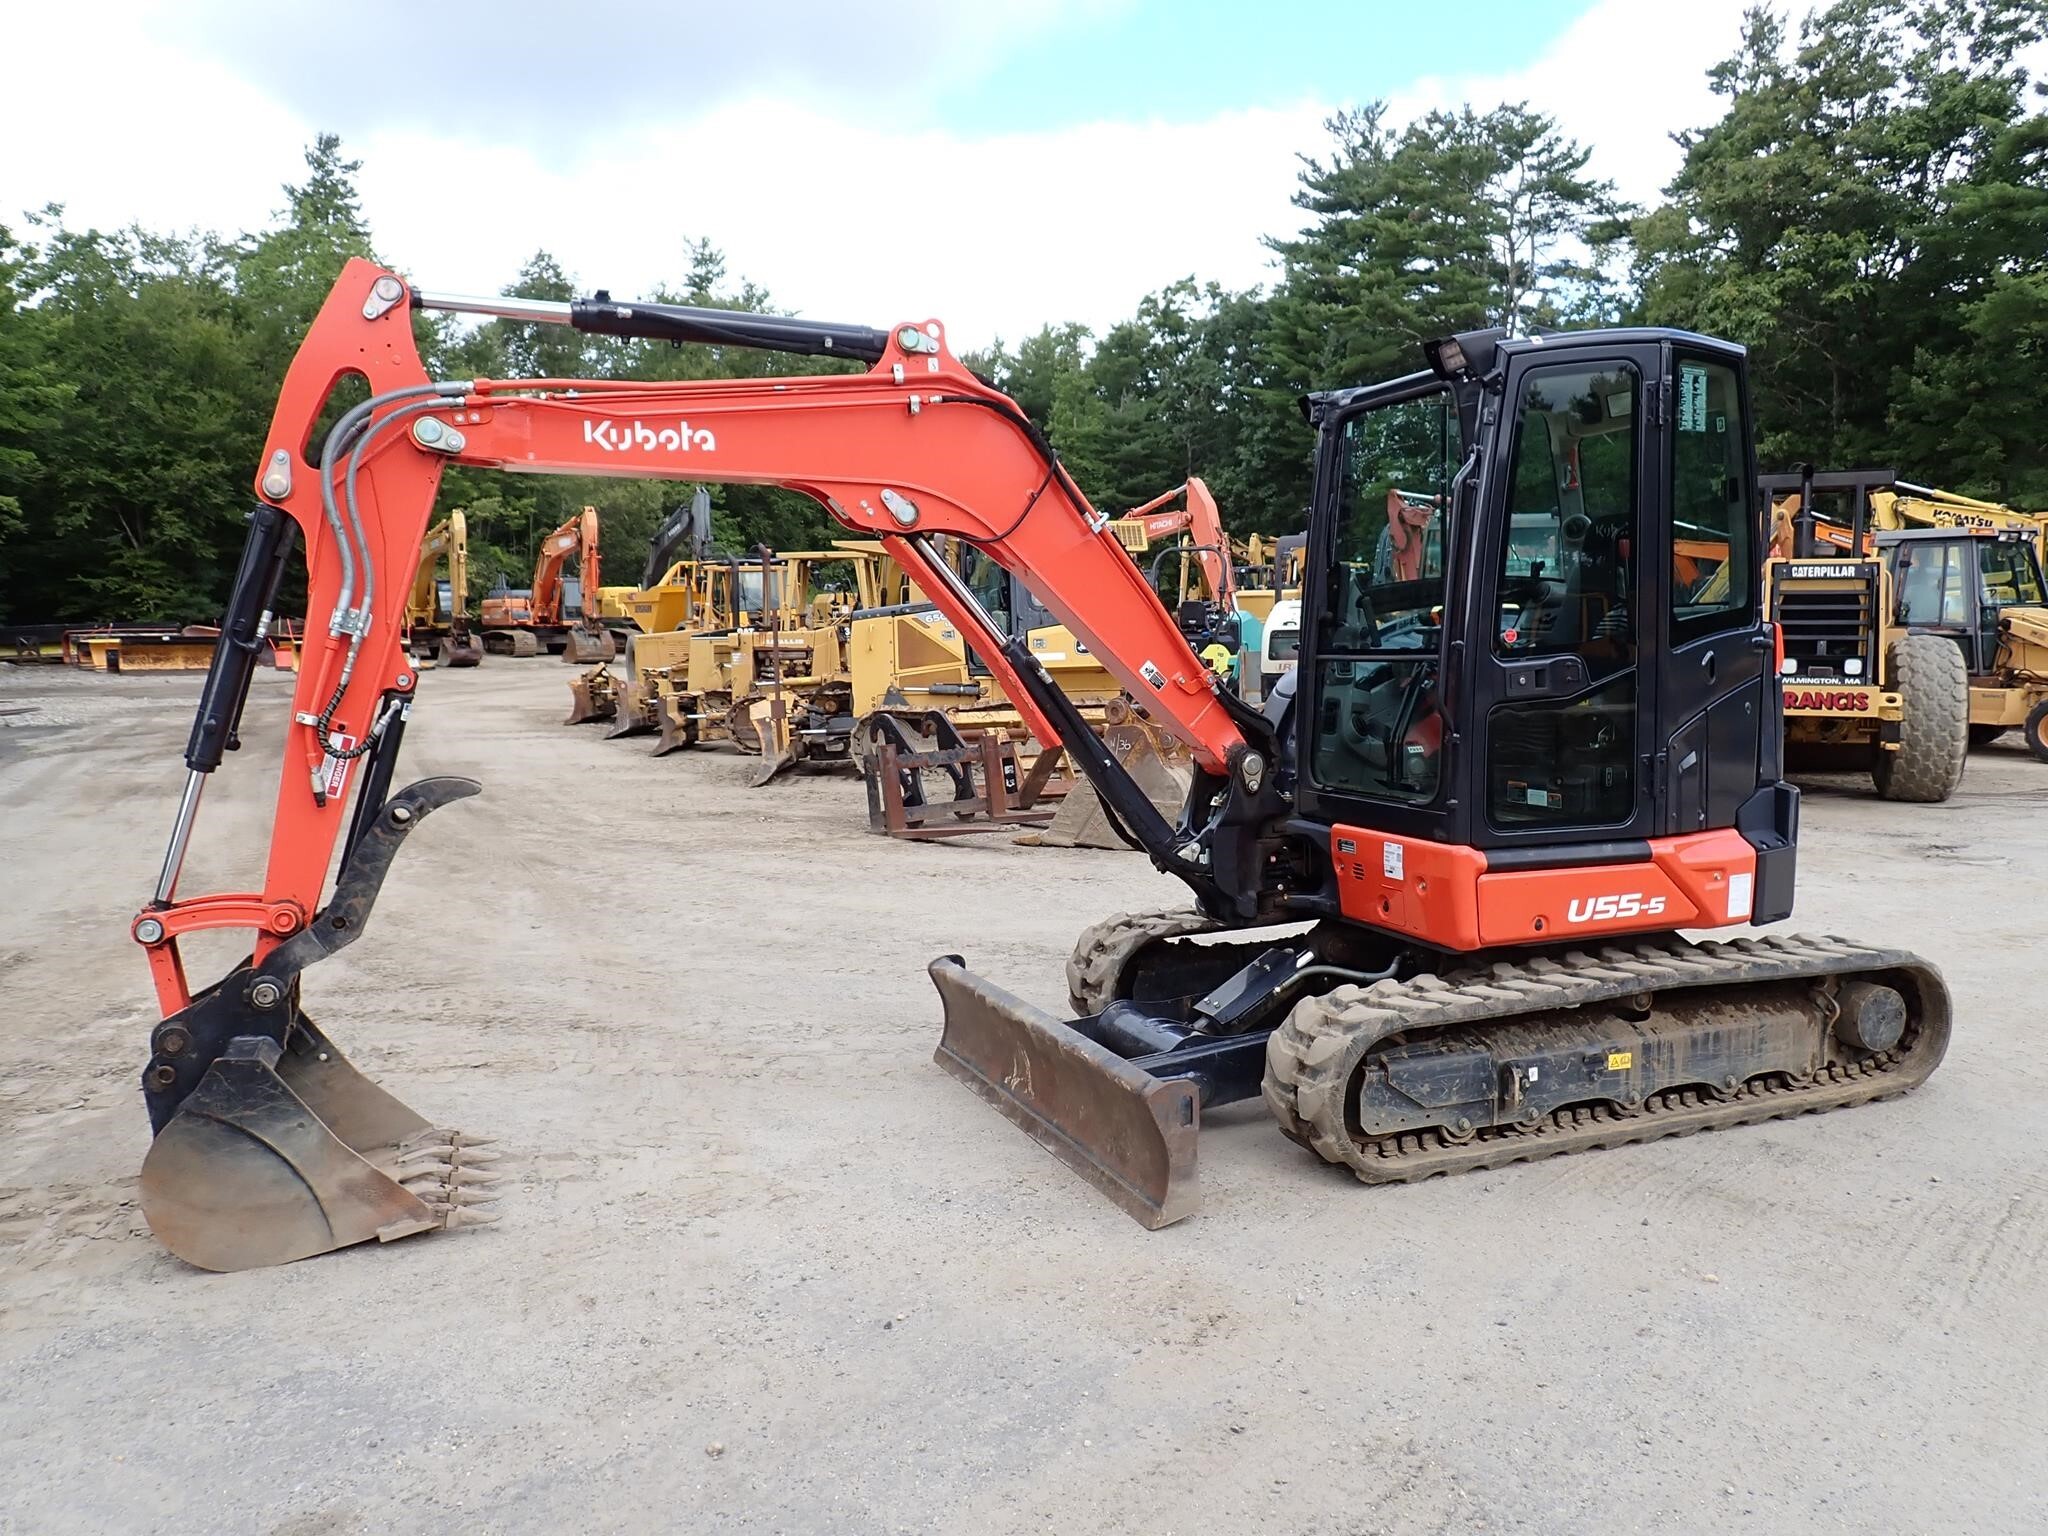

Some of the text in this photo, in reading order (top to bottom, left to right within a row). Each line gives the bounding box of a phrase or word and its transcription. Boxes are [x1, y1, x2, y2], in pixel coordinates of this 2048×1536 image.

[583, 420, 716, 452] Kubota
[1150, 519, 1172, 530] HITACHI
[1791, 566, 1855, 577] CATERPILLAR
[331, 758, 346, 788] ANGER
[1567, 893, 1666, 923] U55-5
